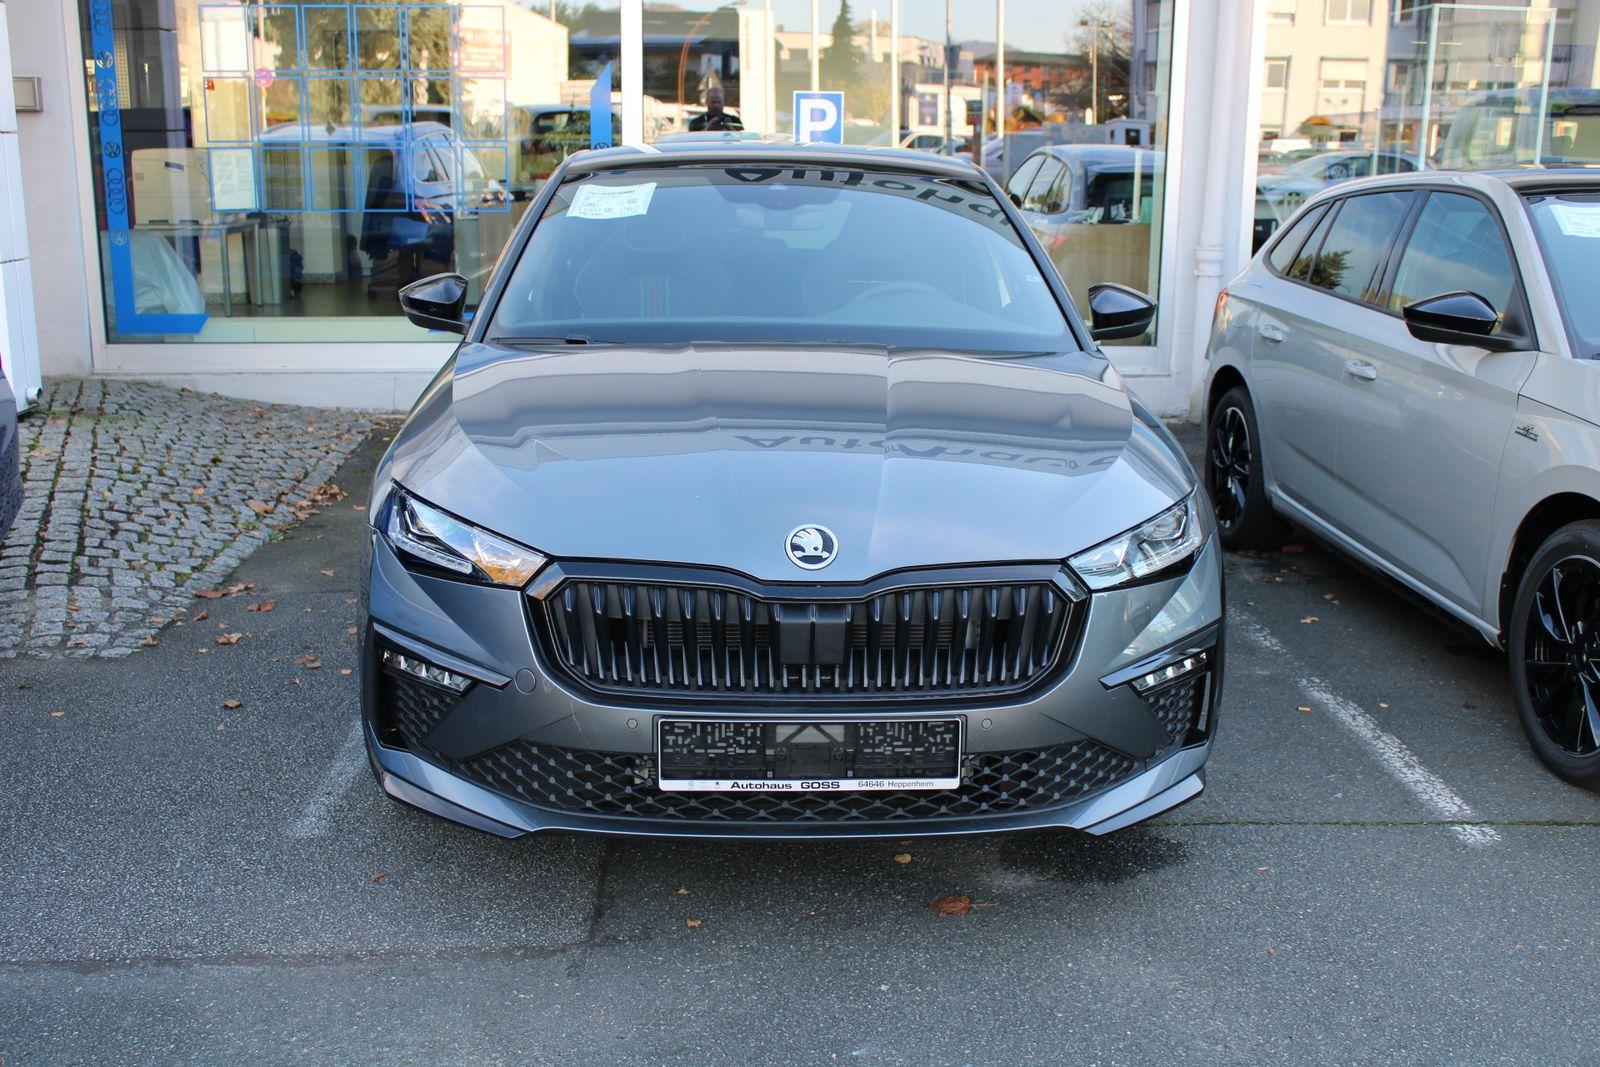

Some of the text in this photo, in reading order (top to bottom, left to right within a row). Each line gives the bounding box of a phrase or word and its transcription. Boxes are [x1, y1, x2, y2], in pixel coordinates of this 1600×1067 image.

[799, 98, 838, 144] P
[730, 781, 793, 790] Autohaus
[800, 781, 841, 790] GOSS
[857, 780, 885, 788] 64646
[887, 779, 934, 789] Heppenheim
